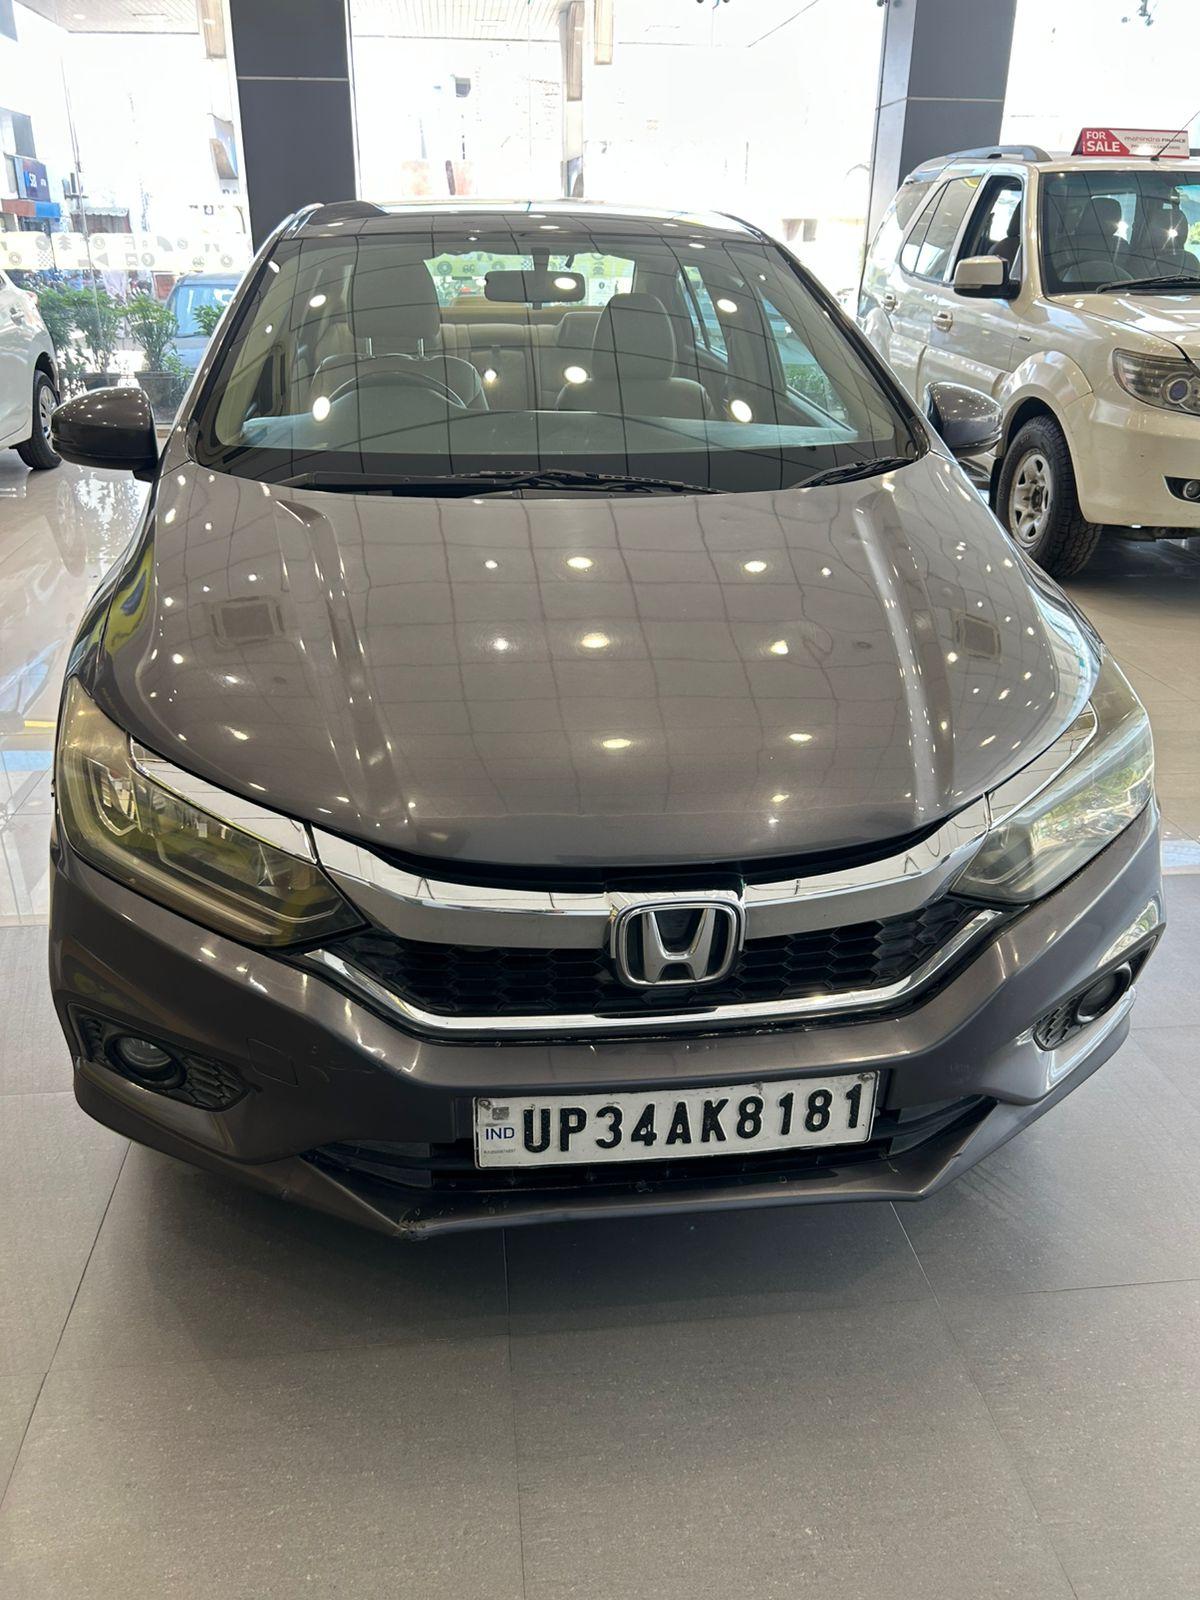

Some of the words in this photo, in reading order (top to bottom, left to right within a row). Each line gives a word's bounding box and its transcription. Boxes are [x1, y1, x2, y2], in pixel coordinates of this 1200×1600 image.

[1086, 131, 1106, 140] FOR
[1086, 141, 1121, 153] SALE
[523, 1083, 863, 1154] UP34AK8181
[485, 1127, 515, 1140] IND
